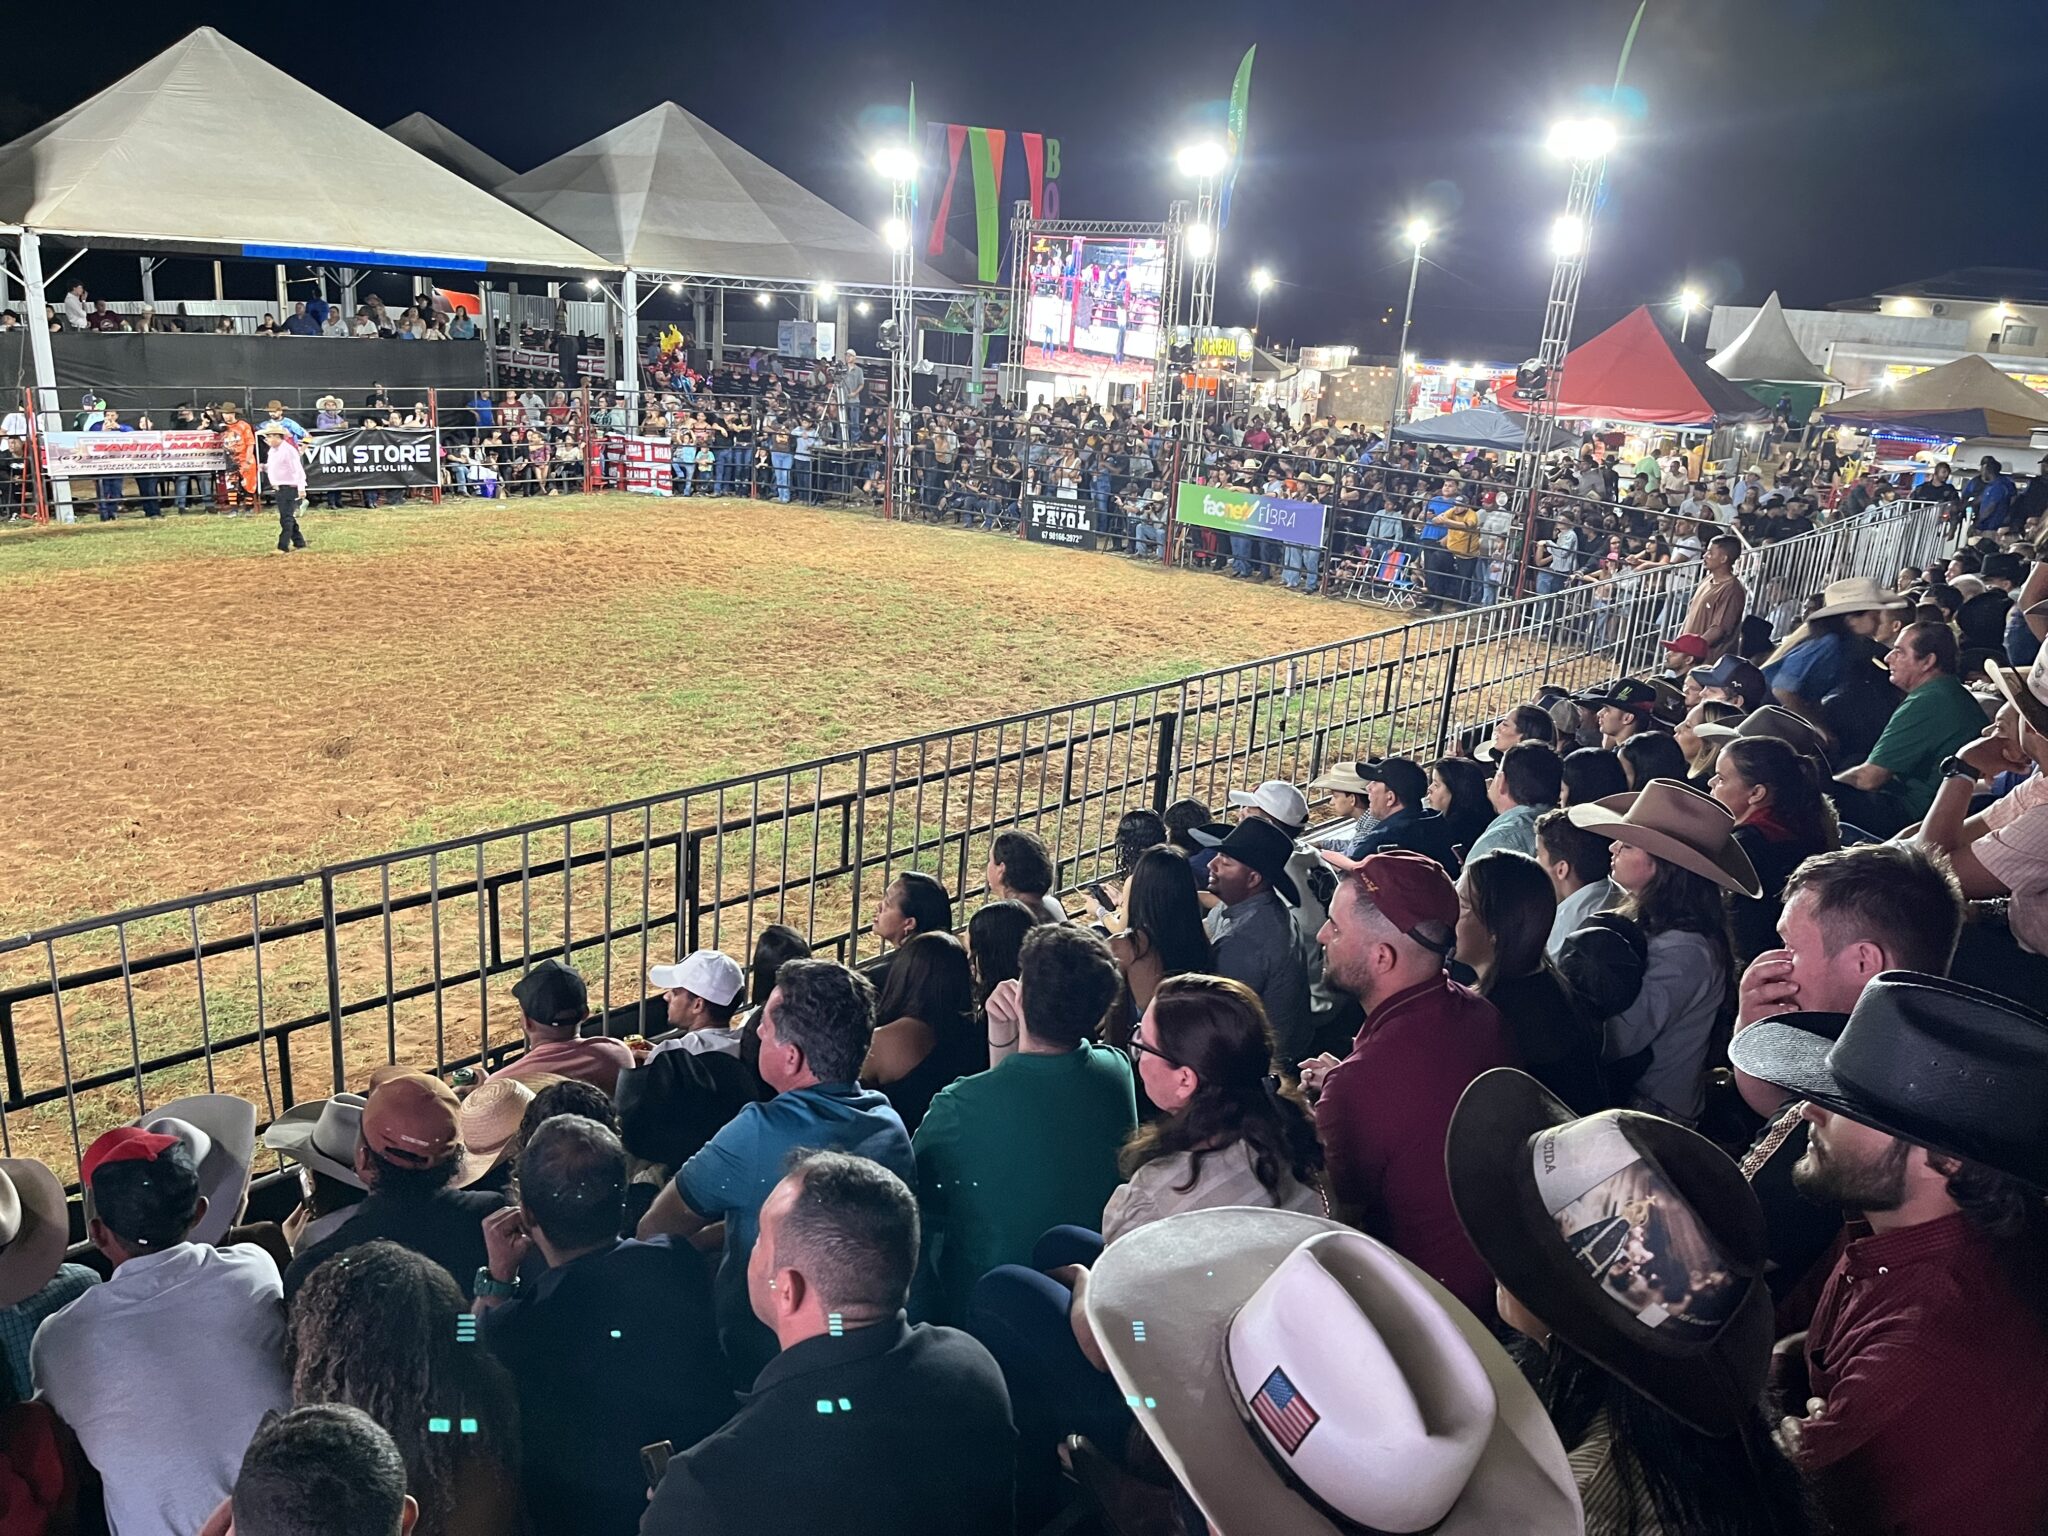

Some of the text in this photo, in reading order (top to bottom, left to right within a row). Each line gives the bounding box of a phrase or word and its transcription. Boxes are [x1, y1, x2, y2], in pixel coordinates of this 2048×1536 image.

[93, 441, 225, 452] SANTA MARI
[304, 444, 432, 465] VINI STORE
[322, 464, 414, 473] MODA MASCULINA
[1031, 500, 1091, 531] PAYOL
[1041, 530, 1049, 539] 67
